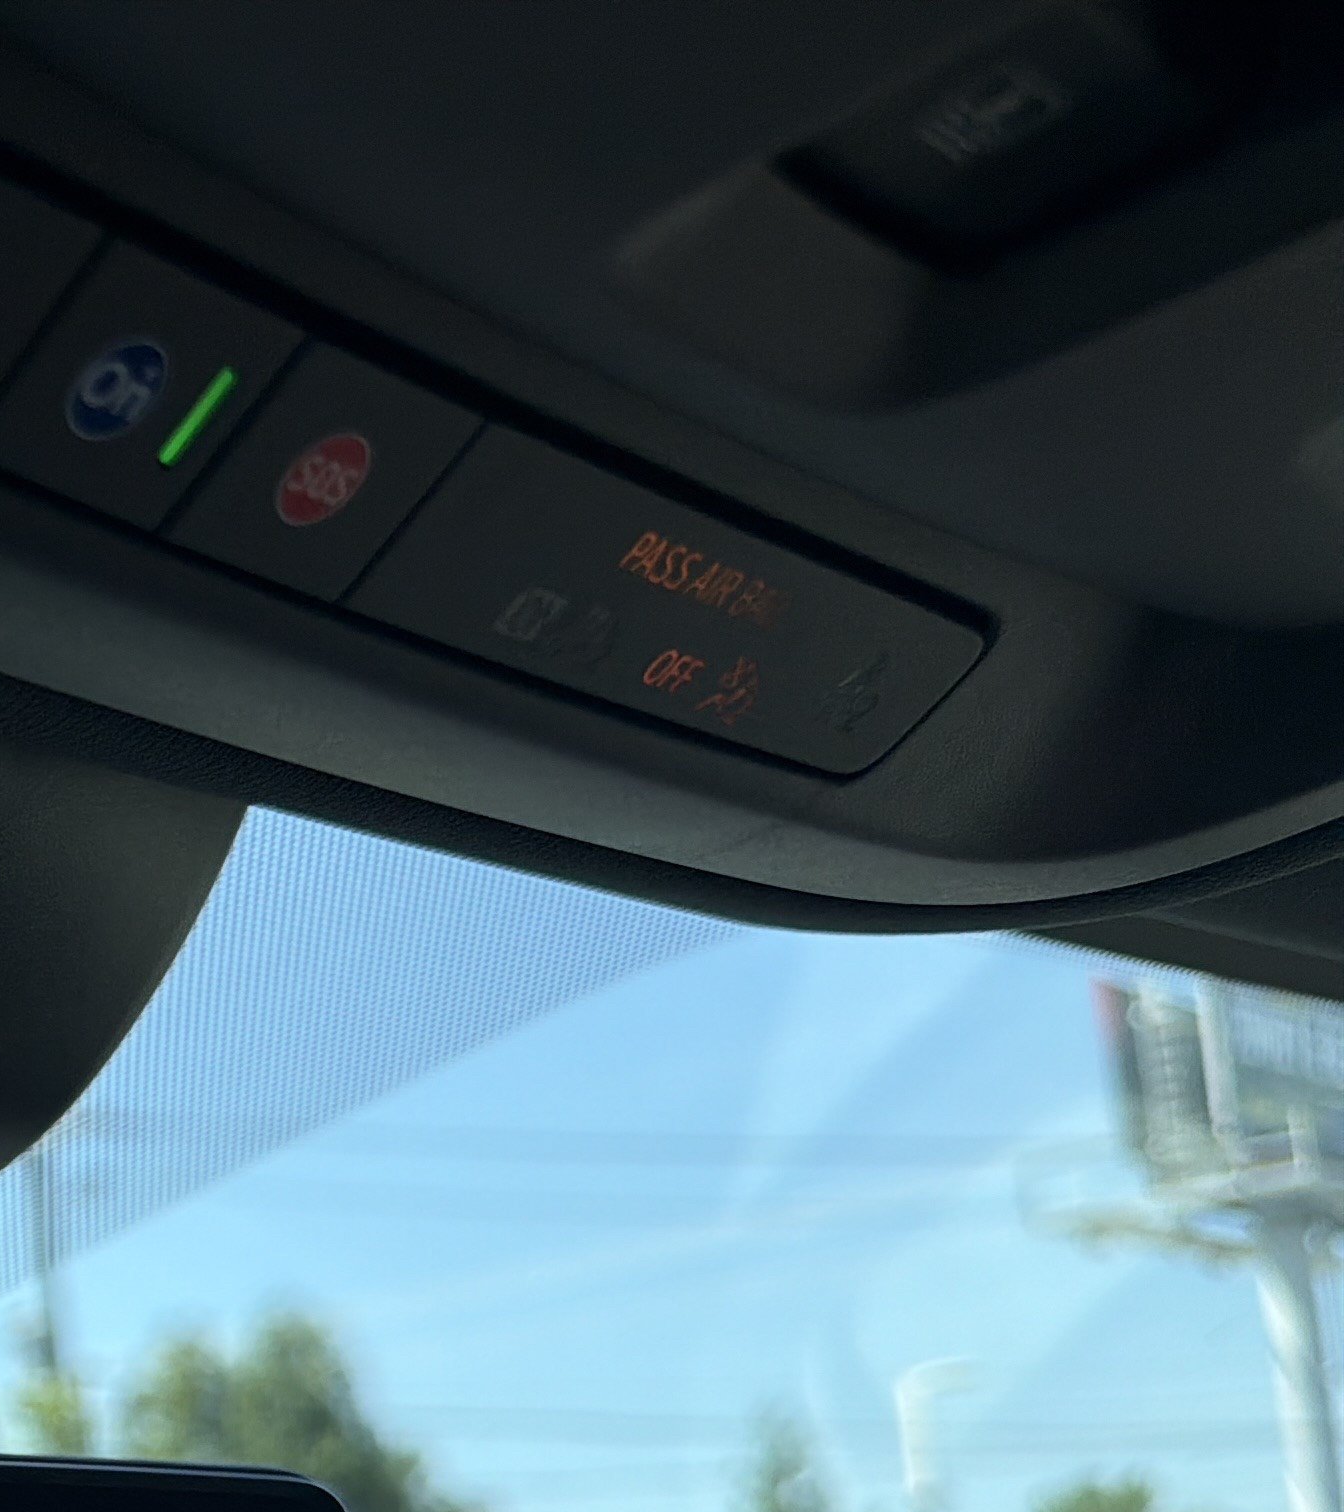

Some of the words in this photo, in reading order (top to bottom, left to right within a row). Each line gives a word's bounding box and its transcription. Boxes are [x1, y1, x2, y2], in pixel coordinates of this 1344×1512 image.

[288, 455, 361, 506] SOS
[619, 530, 703, 591] PASS
[642, 647, 706, 694] OFF
